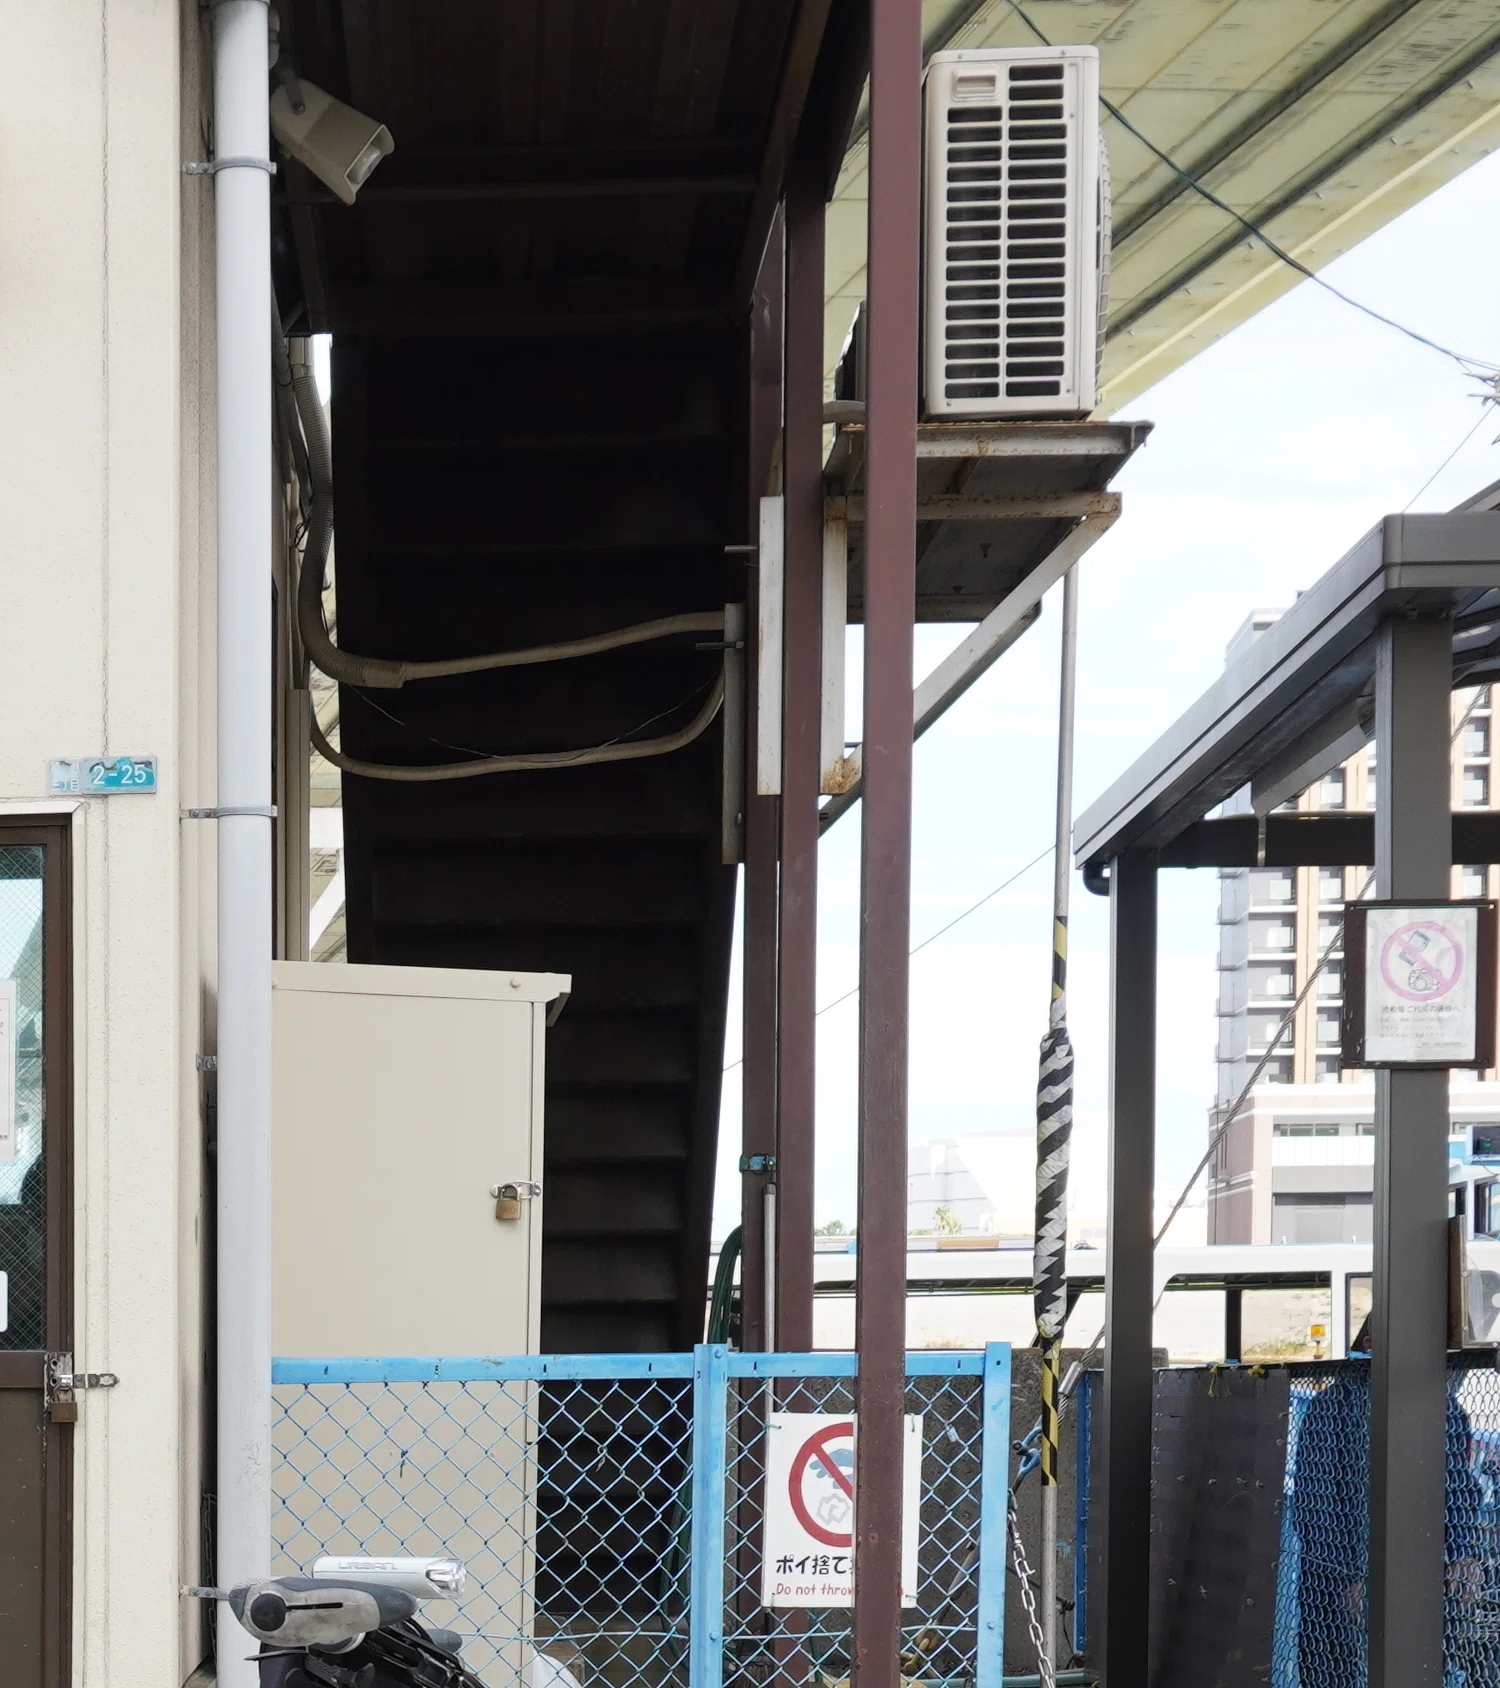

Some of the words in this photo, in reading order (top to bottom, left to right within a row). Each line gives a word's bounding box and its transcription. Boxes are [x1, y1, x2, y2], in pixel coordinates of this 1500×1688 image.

[92, 764, 146, 785] 2-25
[776, 1554, 853, 1575] ポイ捨て
[776, 1583, 792, 1595] Do
[796, 1583, 816, 1595] not
